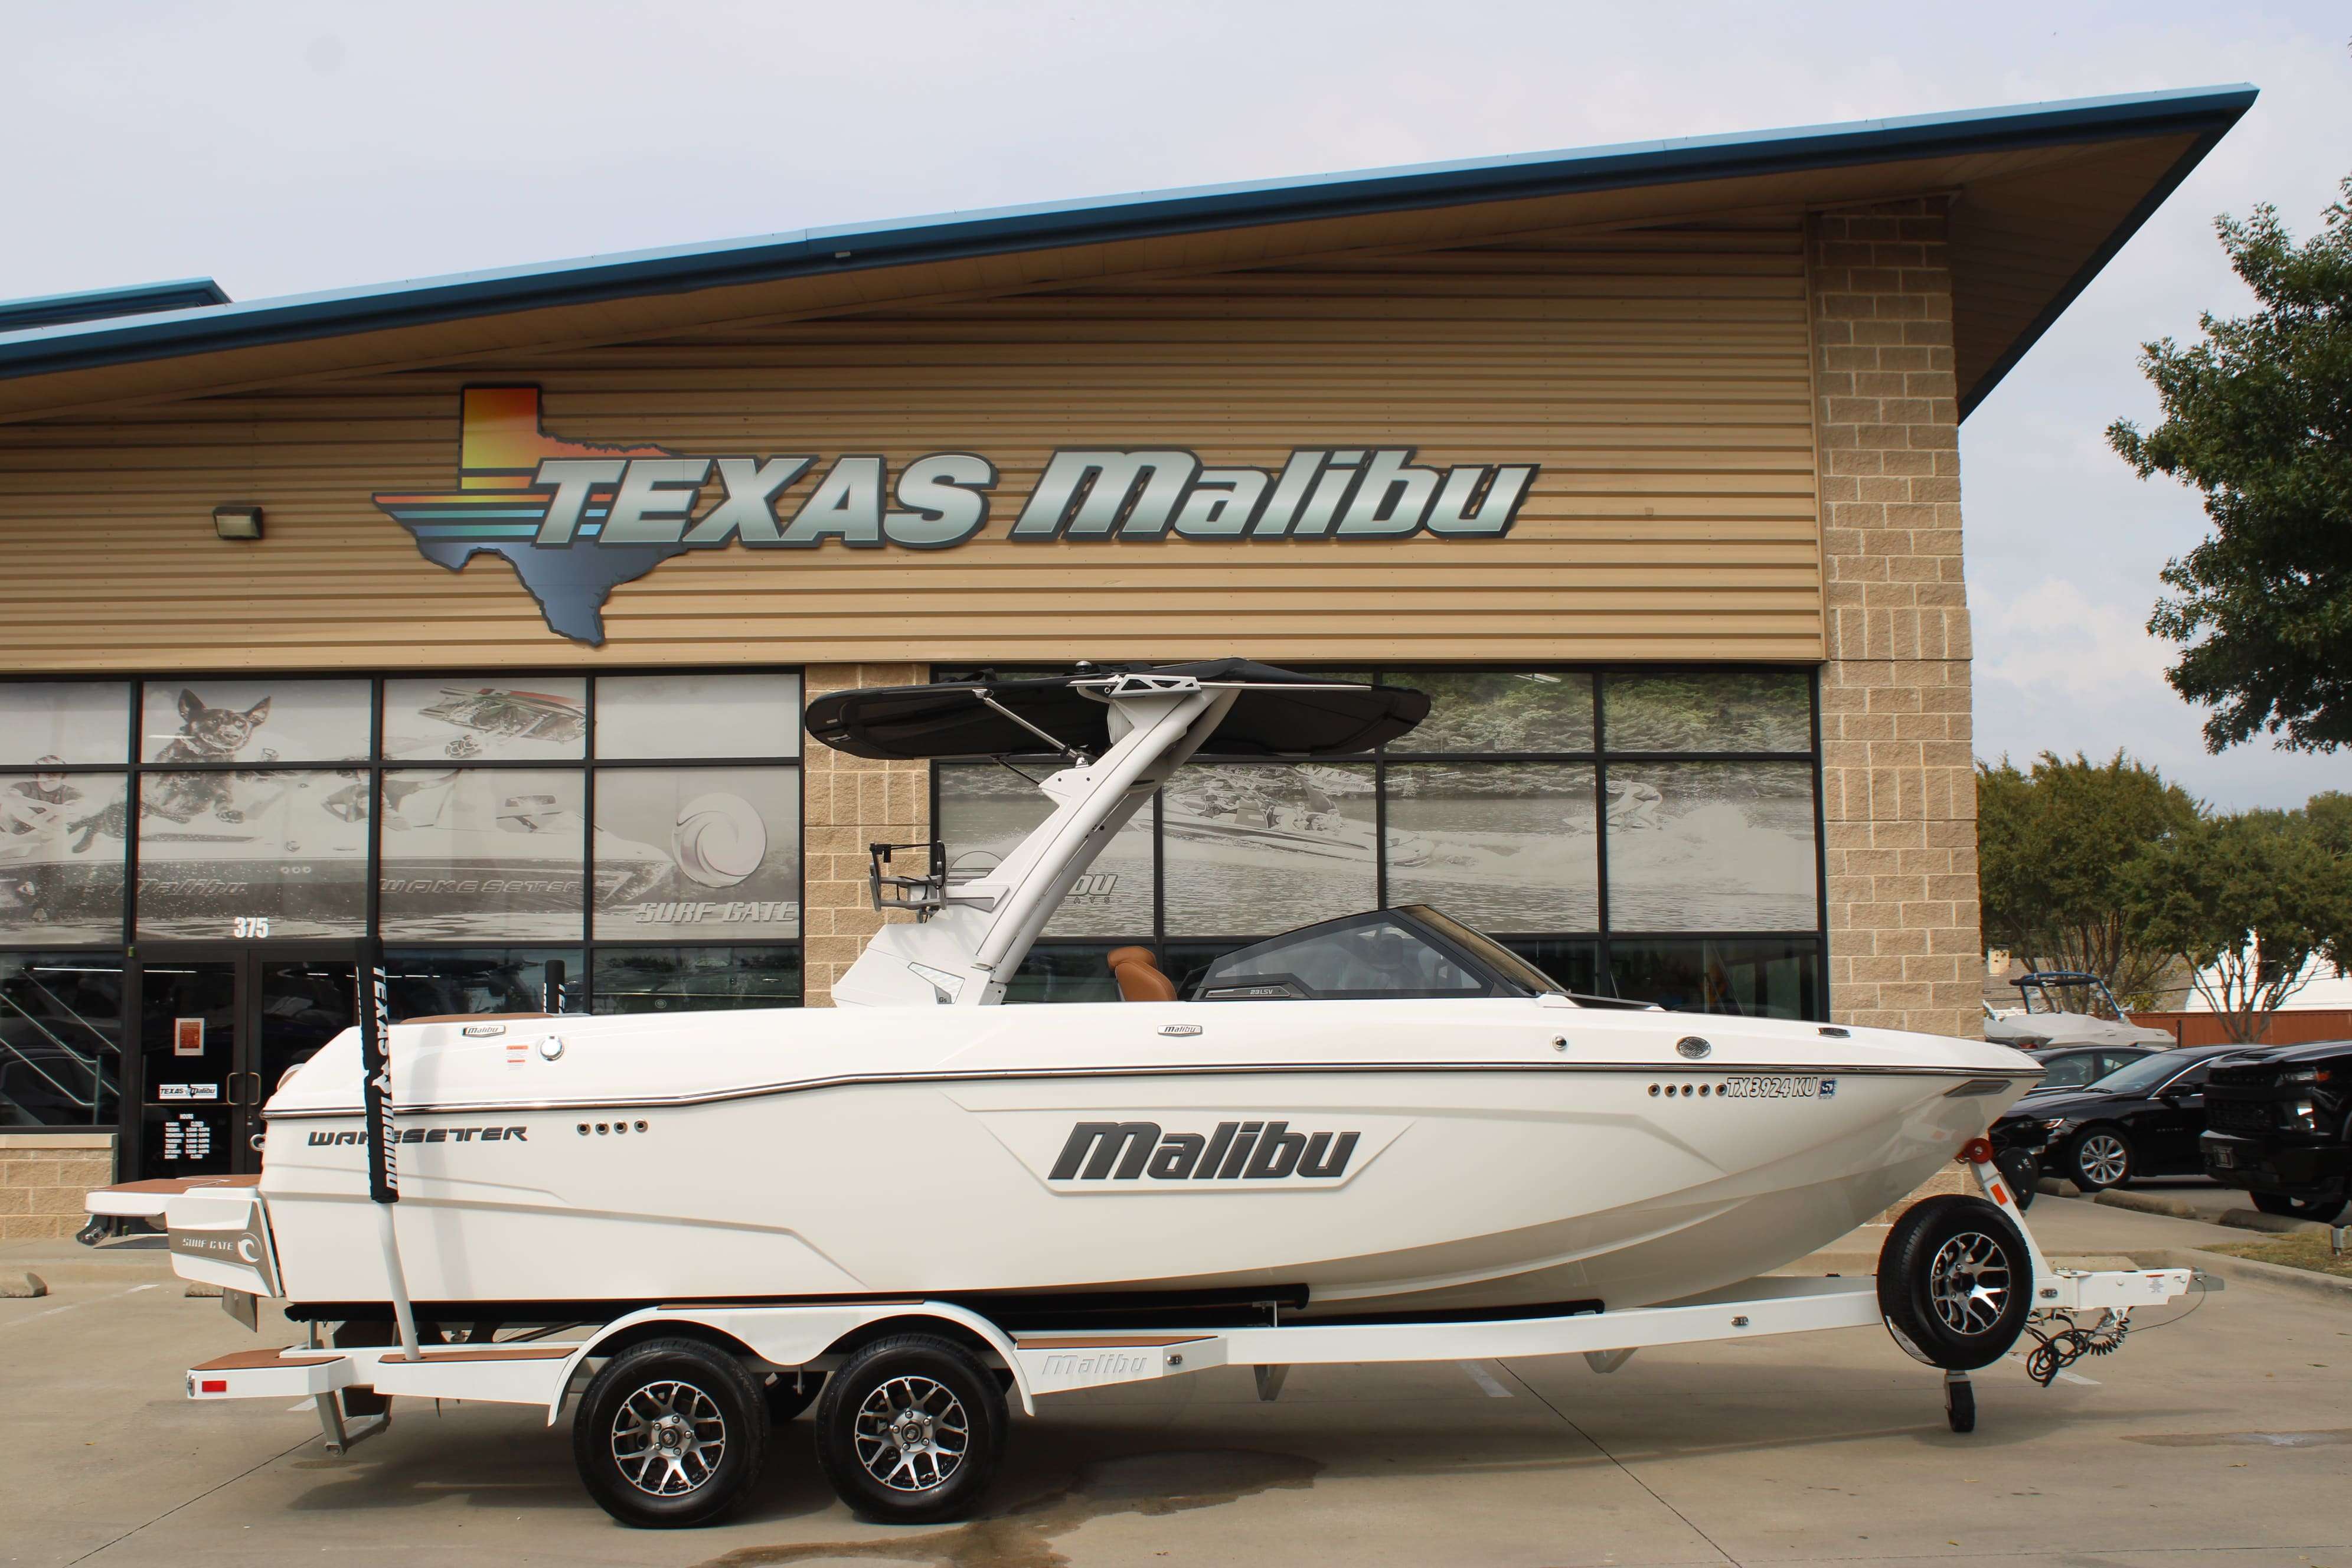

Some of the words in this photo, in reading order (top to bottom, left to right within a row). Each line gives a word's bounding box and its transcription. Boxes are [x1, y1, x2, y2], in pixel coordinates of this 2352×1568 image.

[534, 453, 994, 545] TEXAS
[1011, 448, 1536, 538] Malibu
[636, 902, 716, 923] SURF
[722, 901, 798, 922] GATE
[234, 916, 269, 938] 375
[1727, 1077, 1750, 1097] TX
[1750, 1077, 1791, 1098] 3924
[1792, 1077, 1817, 1097] KU
[1047, 1121, 1361, 1180] Malibu
[1041, 1354, 1148, 1375] Malibu
